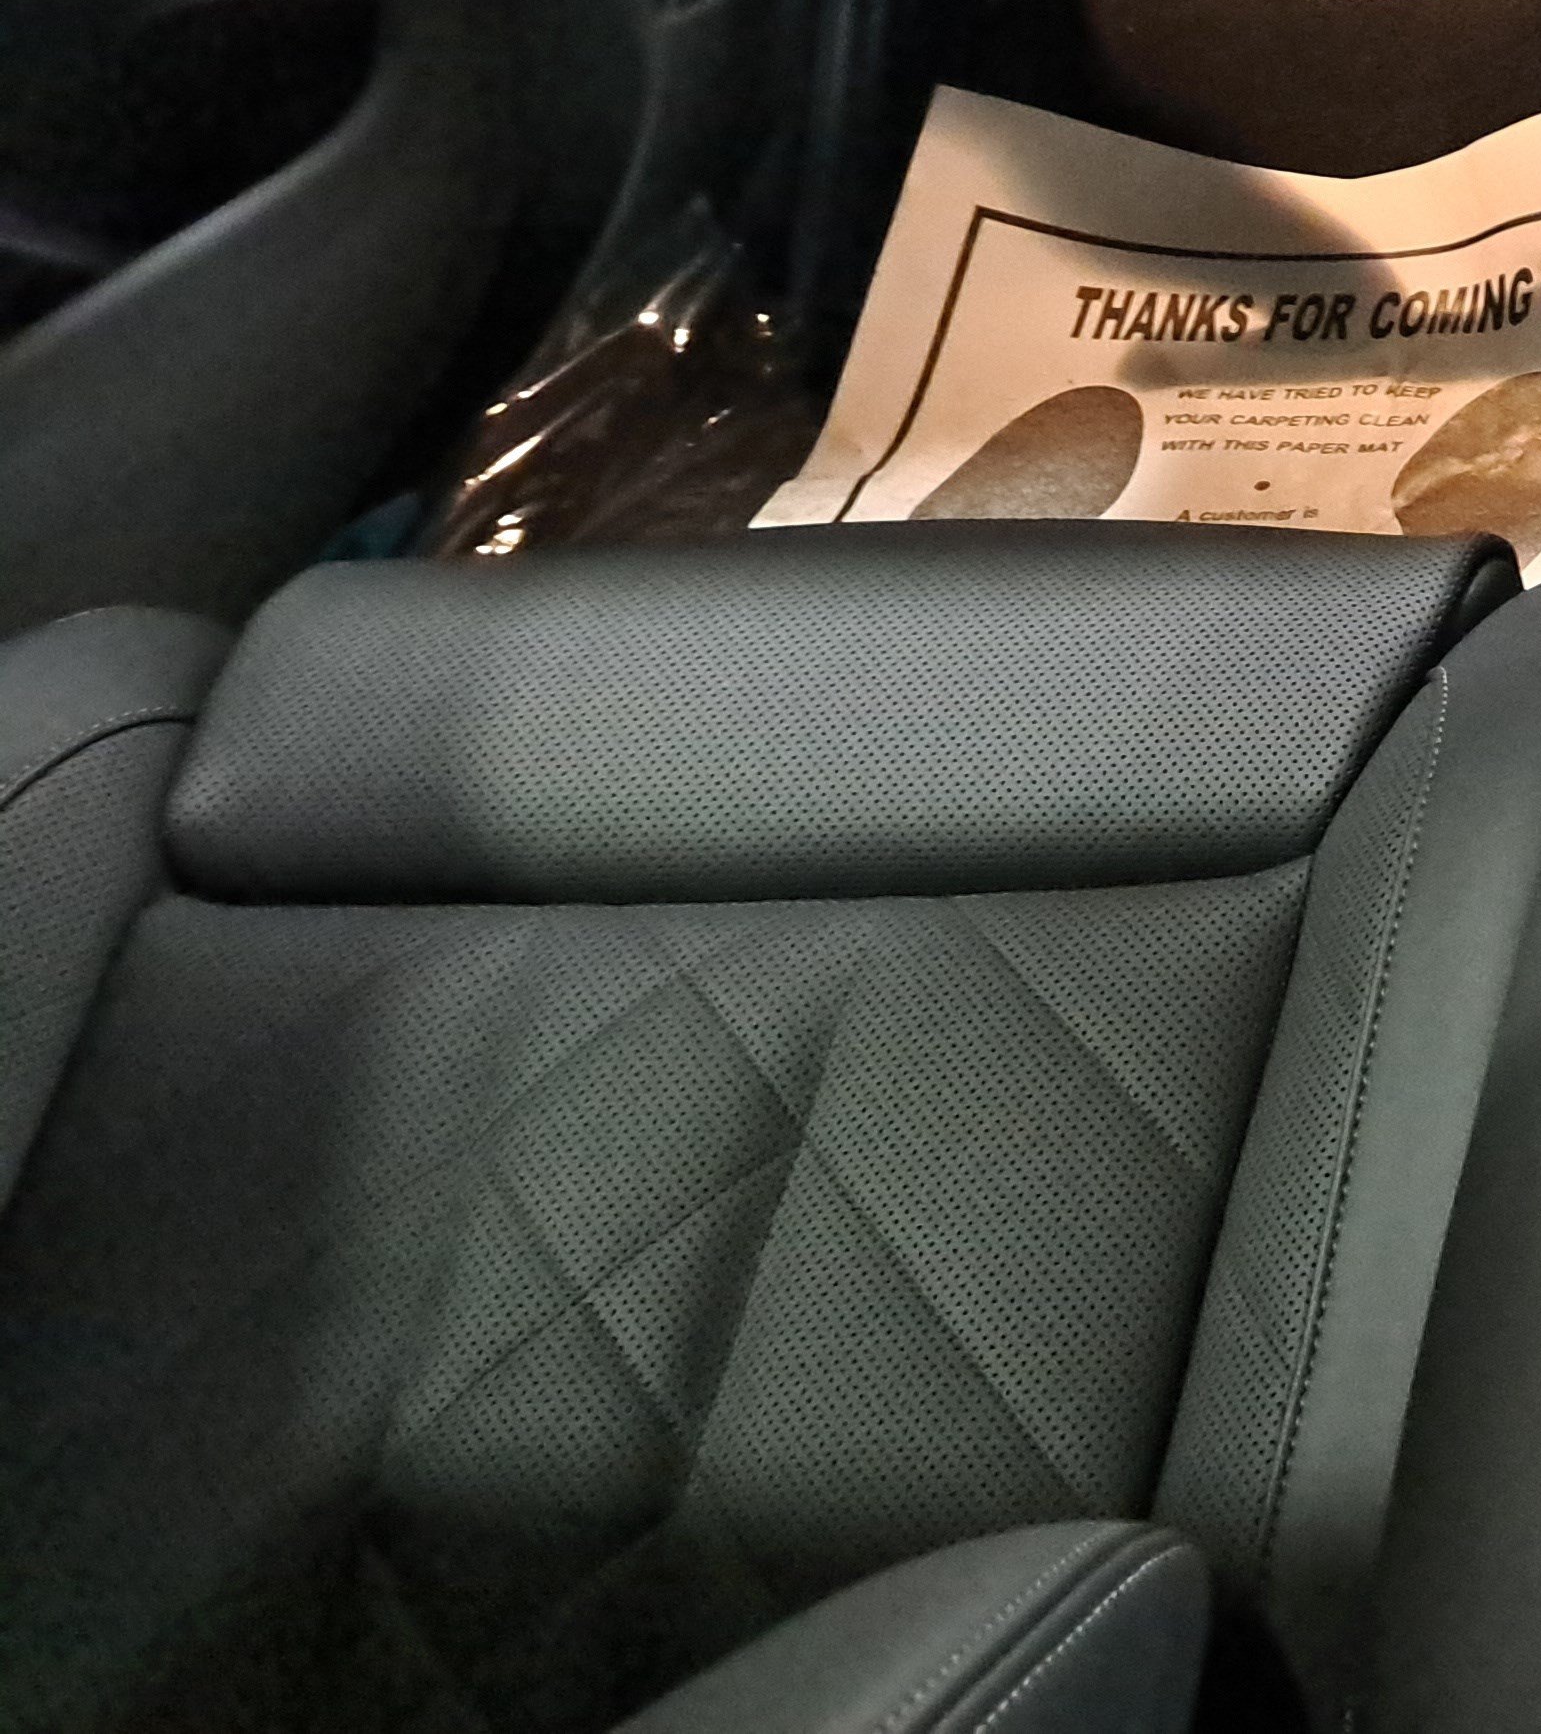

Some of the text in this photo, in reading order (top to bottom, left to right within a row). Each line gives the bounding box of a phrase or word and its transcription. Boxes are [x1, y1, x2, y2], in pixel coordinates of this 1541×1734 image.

[1070, 286, 1255, 343] THANKS
[1264, 293, 1356, 341] FOR
[1370, 266, 1534, 340] COMING
[1178, 383, 1442, 401] WE HAVE TRIED TO KEEP
[1164, 413, 1431, 427] YOUR CARPETING CLEAN
[1161, 439, 1404, 454] WITH THIS PAPER MAT
[1174, 509, 1191, 523] A
[1199, 509, 1297, 522] customer
